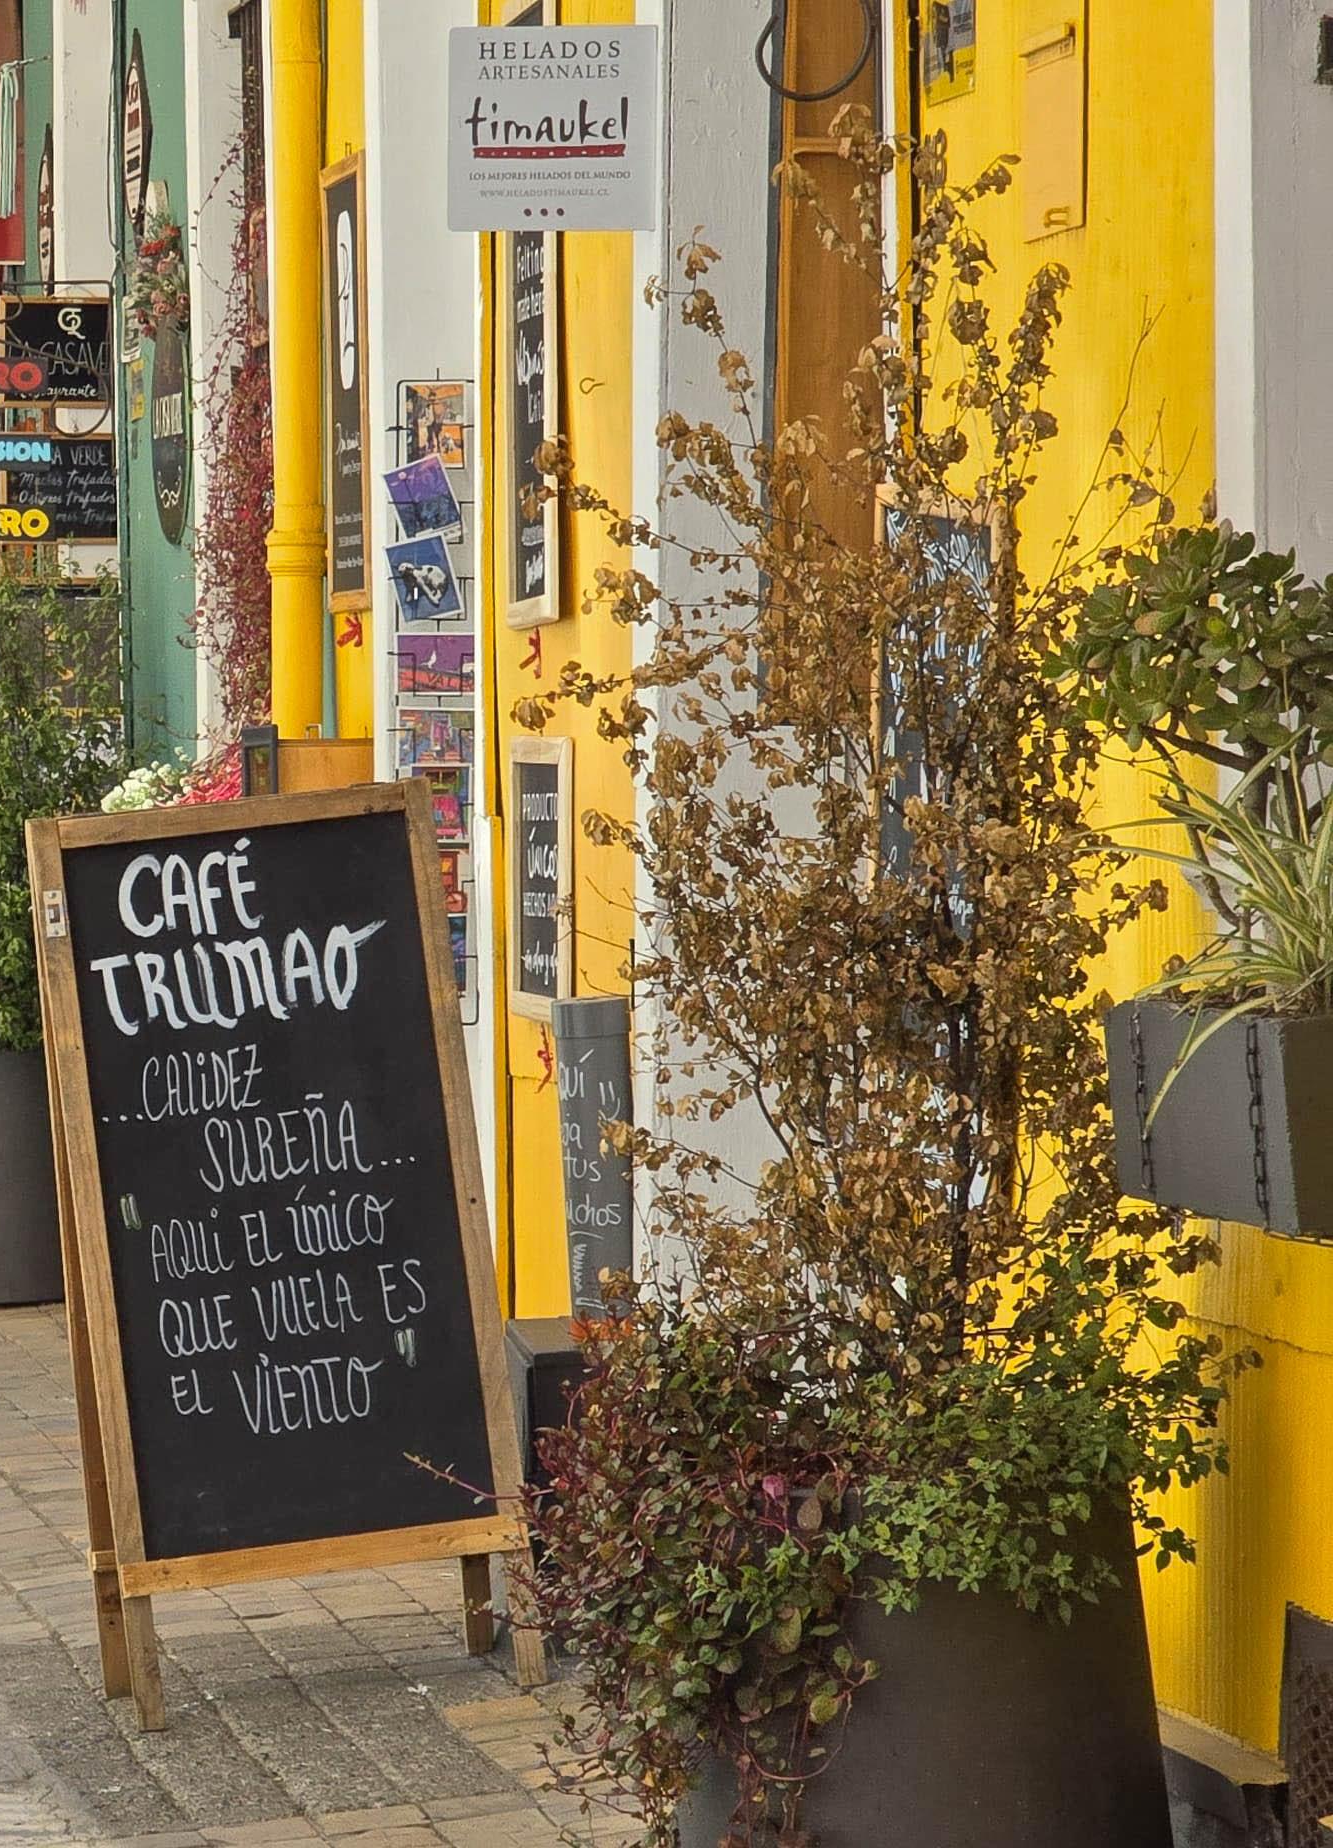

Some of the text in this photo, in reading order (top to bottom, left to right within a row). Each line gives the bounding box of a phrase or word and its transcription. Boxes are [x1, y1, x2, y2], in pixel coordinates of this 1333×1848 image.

[478, 40, 621, 60] HELADOS
[478, 63, 620, 81] ARTESANALES
[464, 96, 629, 146] timaukel
[469, 170, 631, 182] LOS MEJORES HELADOS DEL MUNDO
[118, 837, 265, 938] CAFÉ
[89, 919, 388, 1037] TRUMAO
[559, 1048, 594, 1101] QUÍ
[566, 1193, 622, 1227] uchos
[239, 1209, 284, 1268] EL
[159, 1258, 427, 1359] QUE VUELA ES
[170, 1368, 214, 1416] EL
